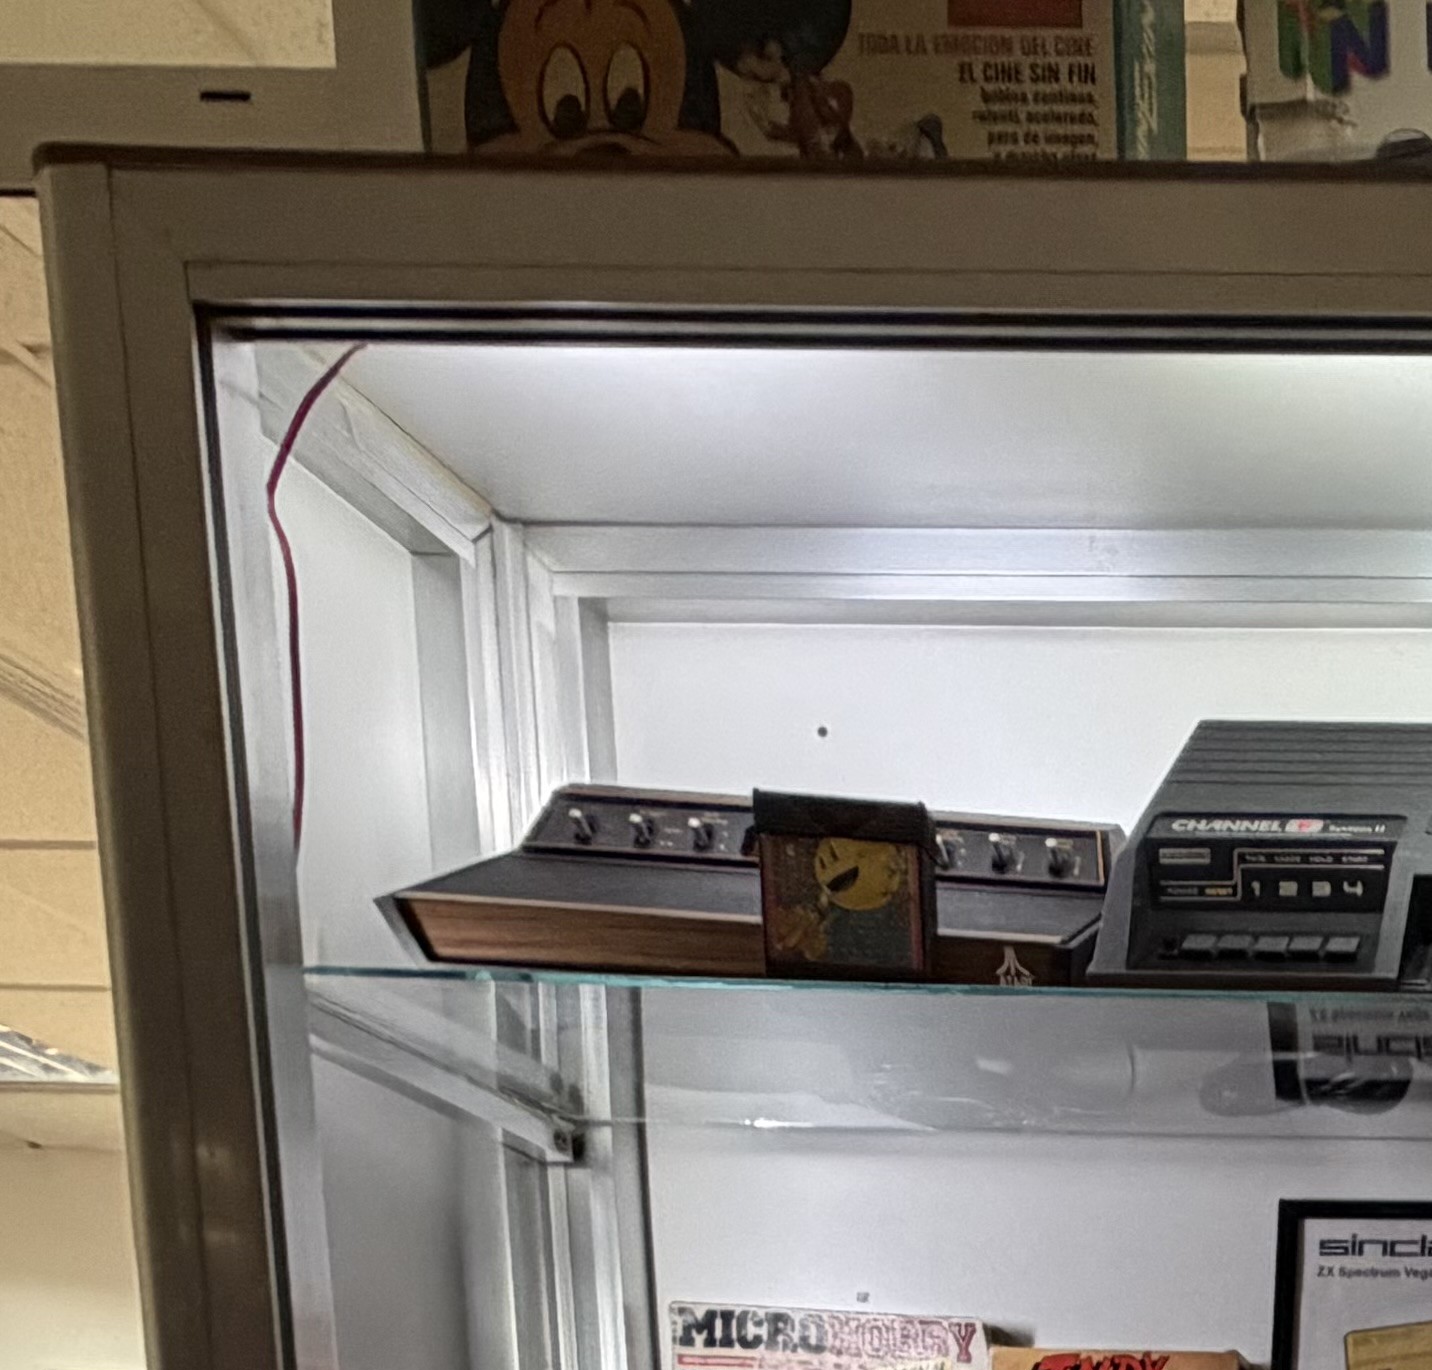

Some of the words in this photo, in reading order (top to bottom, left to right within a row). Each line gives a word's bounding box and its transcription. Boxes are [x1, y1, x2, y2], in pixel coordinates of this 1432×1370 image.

[959, 63, 978, 83] EL
[982, 63, 1022, 83] CINE
[1030, 63, 1060, 84] SIN
[1068, 64, 1097, 85] FIN
[1170, 818, 1283, 833] CHANNEL
[1252, 881, 1261, 897] 1
[1342, 881, 1364, 897] 4
[1316, 1266, 1336, 1279] ZX
[1338, 1267, 1401, 1283] Spectrum
